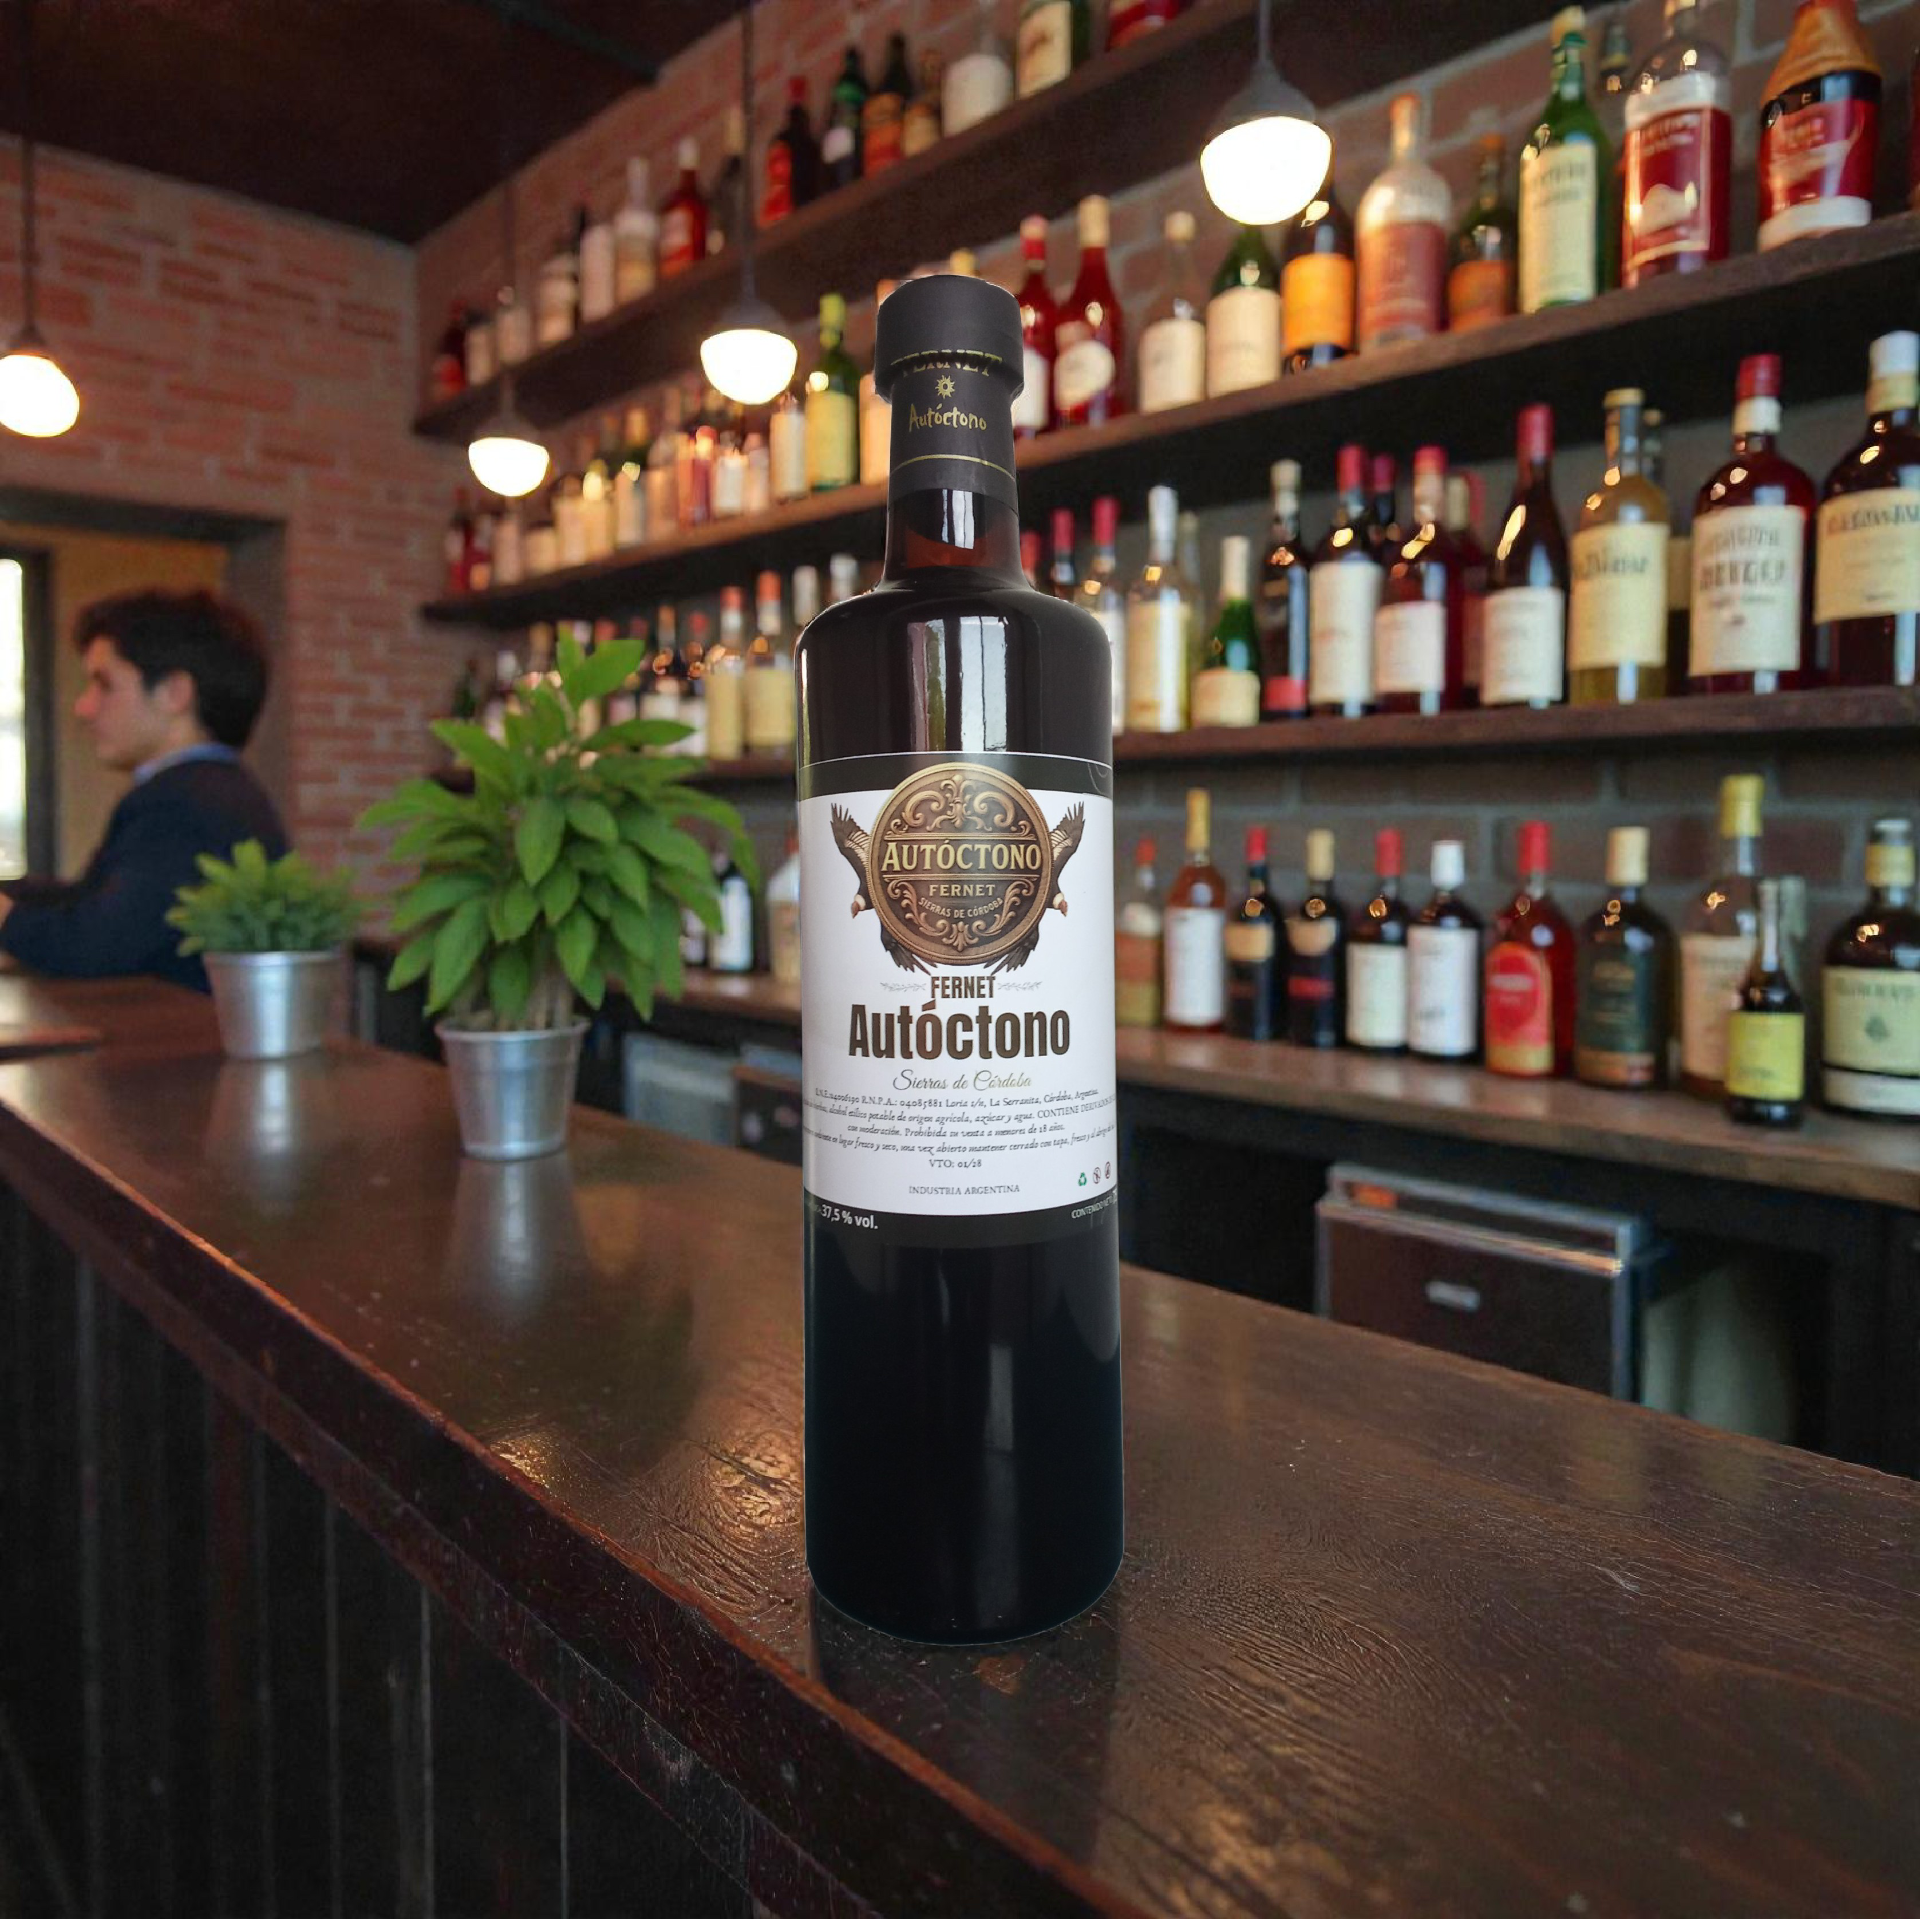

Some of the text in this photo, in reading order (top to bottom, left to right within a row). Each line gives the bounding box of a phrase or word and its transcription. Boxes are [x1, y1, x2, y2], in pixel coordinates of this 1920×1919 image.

[909, 403, 987, 433] Autóctono
[881, 839, 1042, 872] AUTÓCTONO
[929, 884, 996, 897] FERNET
[918, 897, 1003, 919] SIERRAS DE CÓRDOBA
[930, 976, 996, 999] FERNET
[848, 1000, 1071, 1060] Autóctono
[892, 1069, 1032, 1091] Sierras de Córdoba
[900, 1098, 943, 1110] 04085881
[990, 1098, 1001, 1107] La
[897, 1110, 907, 1121] de
[908, 1115, 934, 1126] origen
[1003, 1114, 1012, 1124] y
[1037, 1105, 1079, 1118] CONTIENE
[994, 1128, 1026, 1136] menores
[1027, 1123, 1037, 1134] de
[1039, 1124, 1047, 1133] 18
[874, 1143, 881, 1152] y
[917, 1145, 935, 1156] vez
[936, 1142, 967, 1153] abierto
[968, 1145, 1008, 1153] mantener
[1009, 1138, 1039, 1151] cerrado
[929, 1158, 982, 1169] VTO: 01/28
[909, 1184, 1020, 1195] INDUSTRIA ARGENTINA
[820, 1204, 841, 1222] 37,5
[841, 1210, 853, 1225] %
[854, 1214, 878, 1230] vol.
